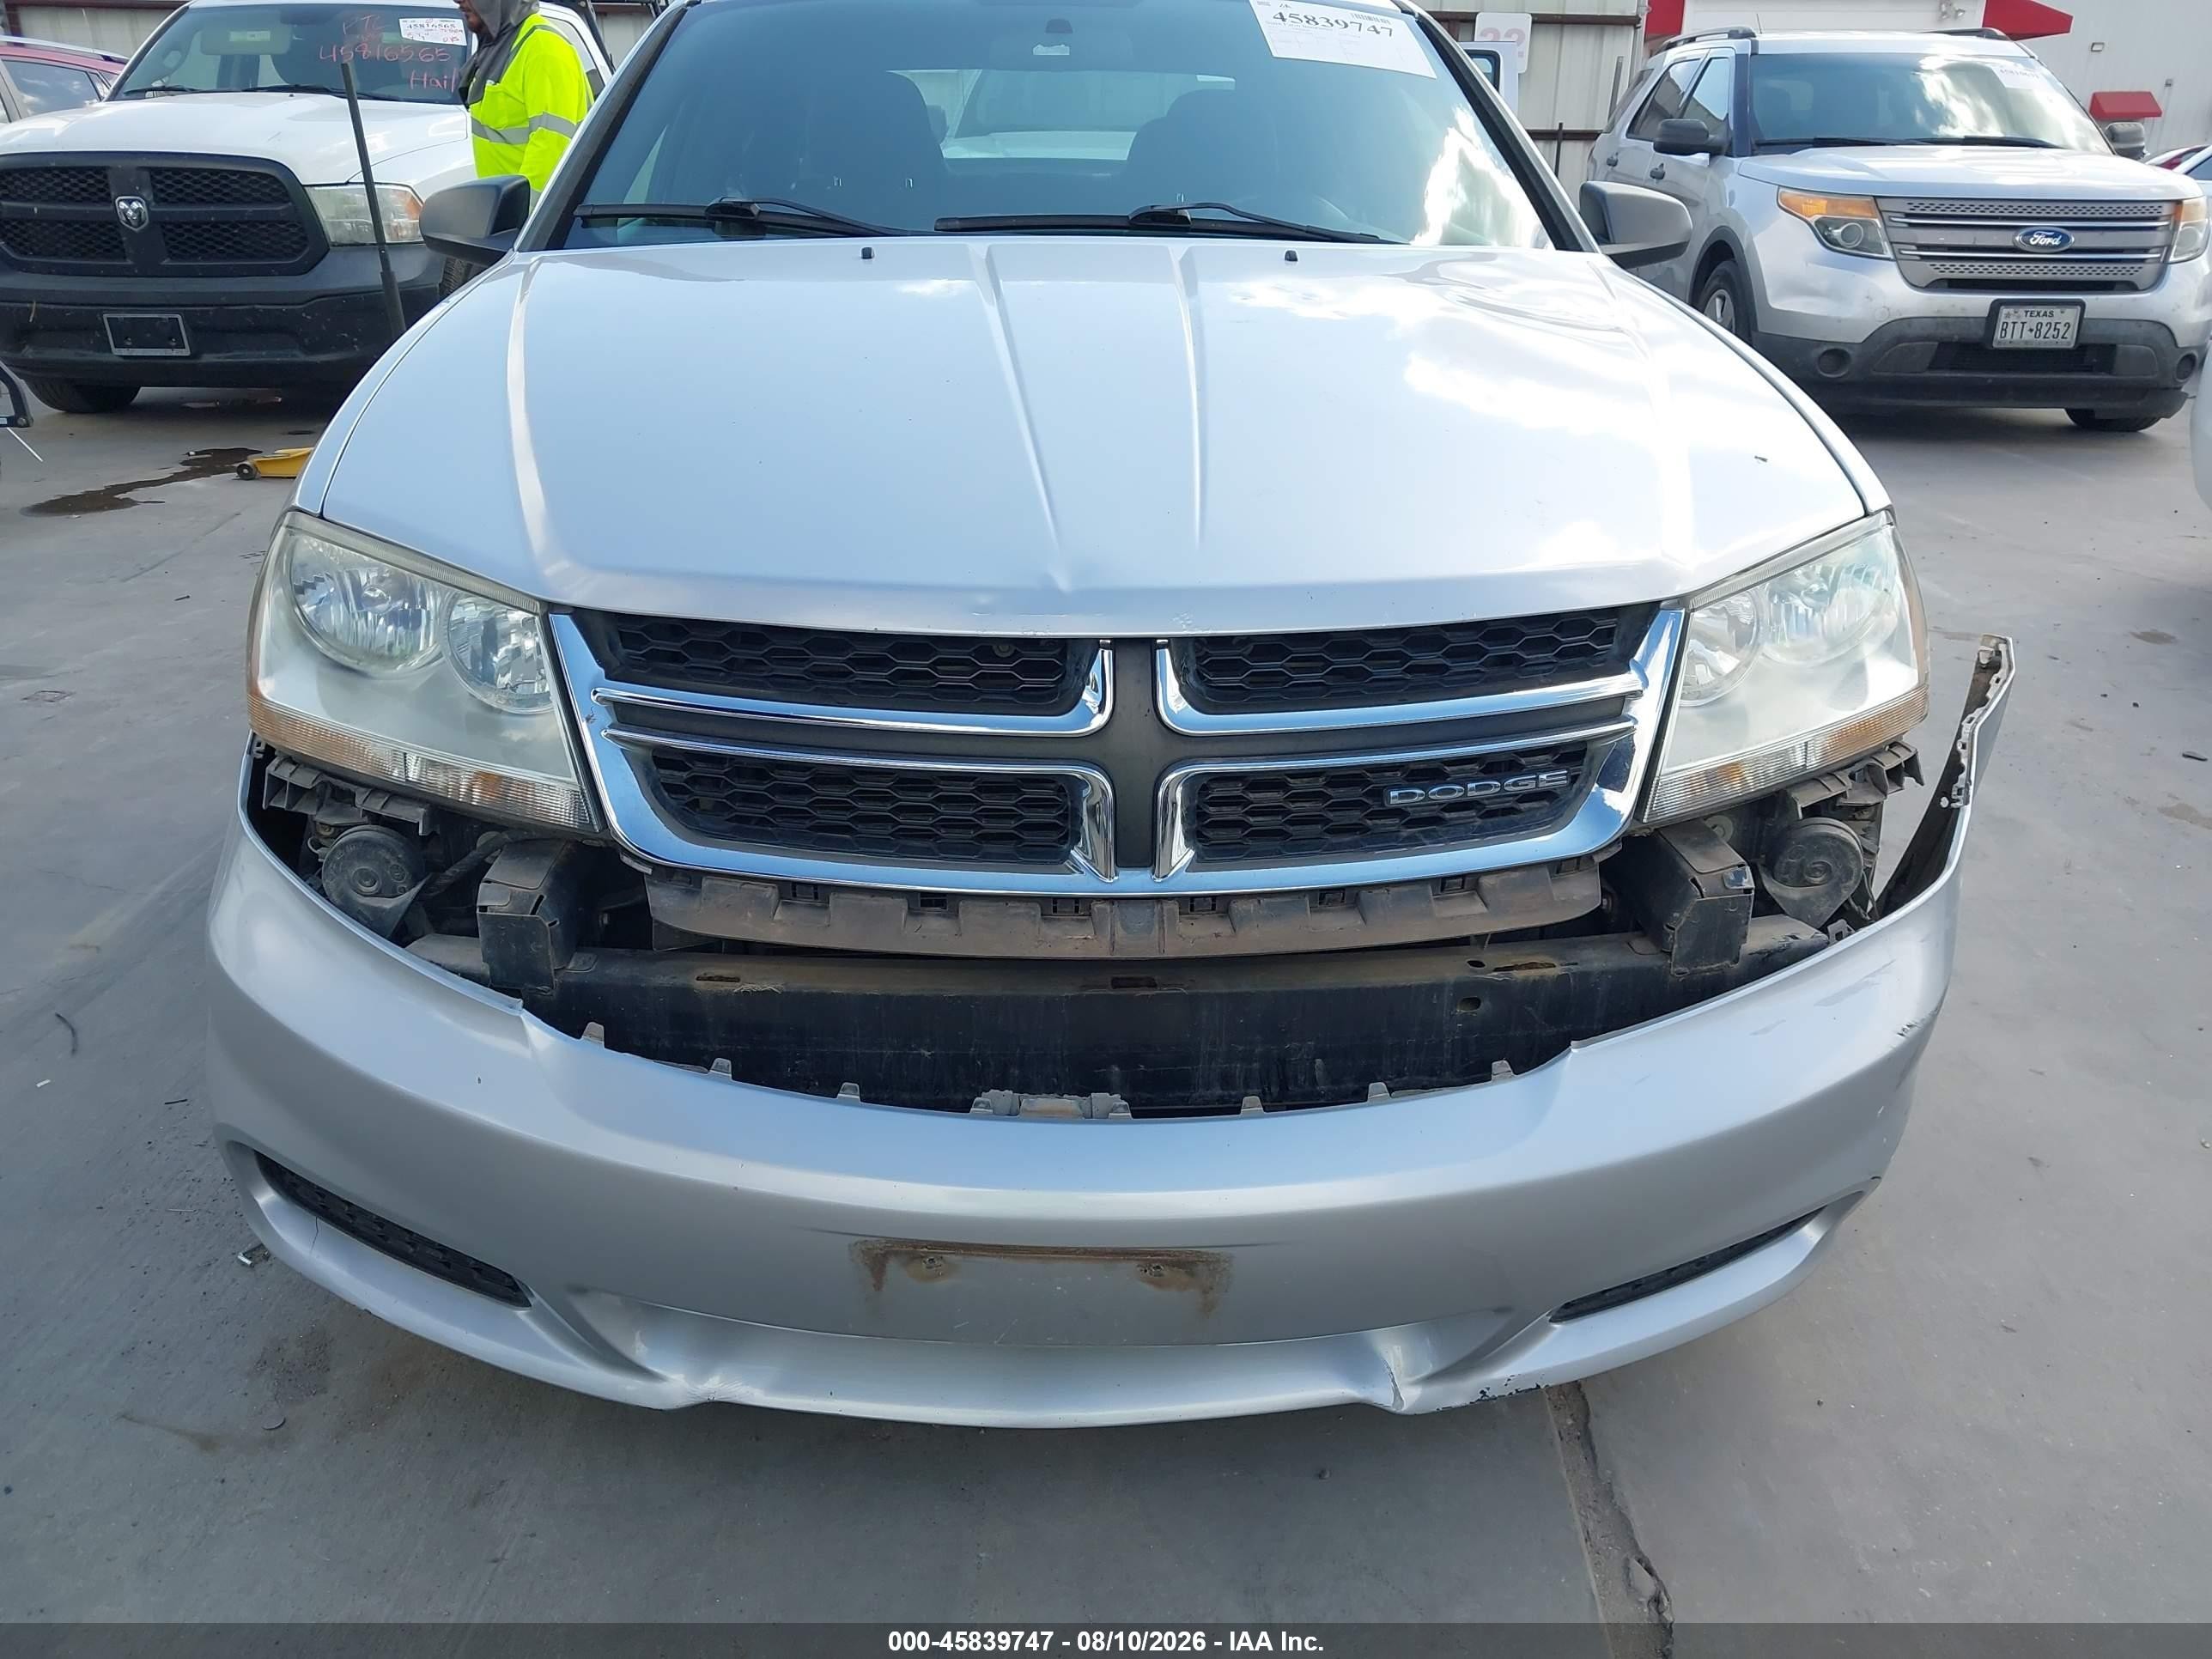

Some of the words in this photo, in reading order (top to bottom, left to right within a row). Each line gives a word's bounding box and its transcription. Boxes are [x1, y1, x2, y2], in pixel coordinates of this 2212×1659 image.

[1273, 11, 1394, 37] 45839747
[319, 41, 452, 63] 45816565
[410, 68, 458, 94] Hail
[2029, 230, 2063, 247] Ford
[2024, 309, 2055, 319] TEXAS
[1389, 769, 1569, 805] DODGE
